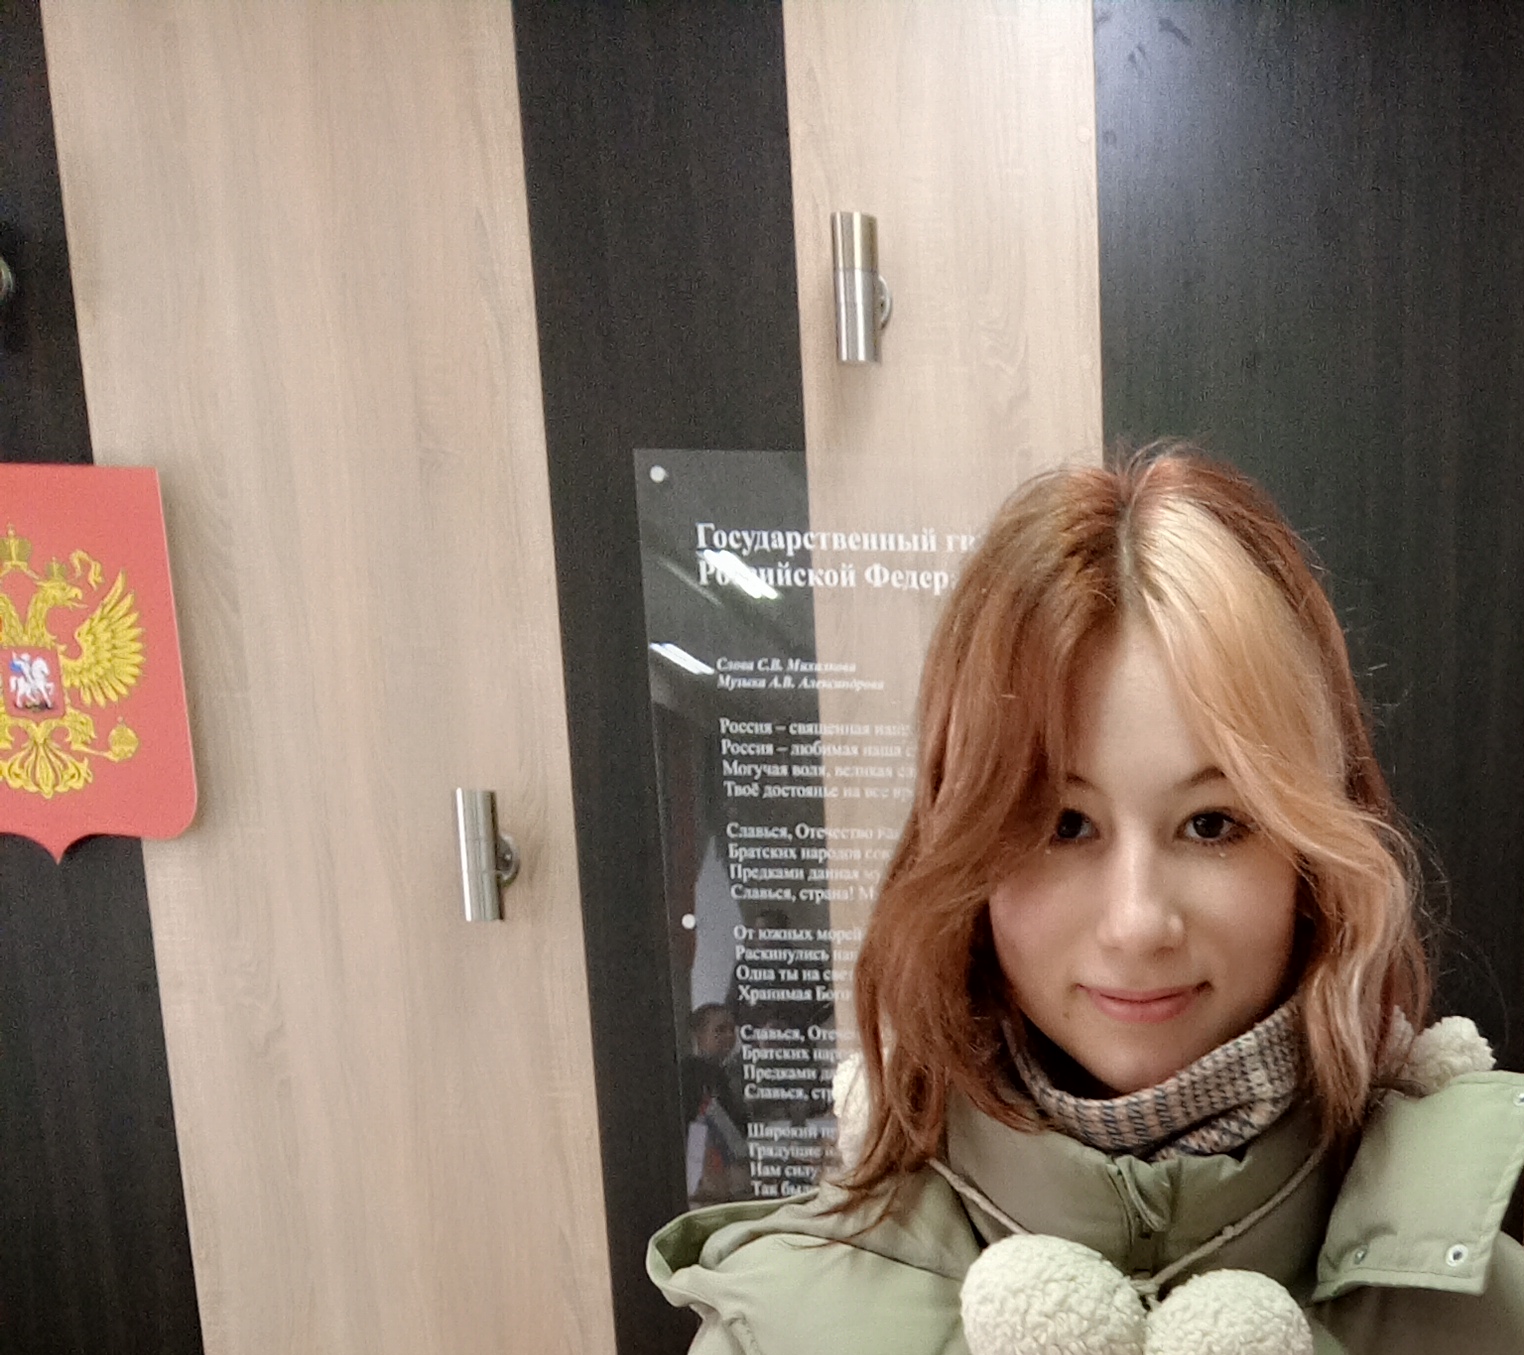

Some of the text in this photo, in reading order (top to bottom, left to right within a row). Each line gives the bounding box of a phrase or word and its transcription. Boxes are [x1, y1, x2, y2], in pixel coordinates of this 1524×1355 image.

[695, 522, 937, 556] Государственный
[698, 559, 955, 595] Роийской Федер
[716, 657, 754, 672] Слова
[757, 658, 783, 672] С.В.
[716, 674, 766, 691] Музыка
[768, 676, 795, 689] А.В.
[719, 718, 772, 735] Россия
[721, 739, 774, 755] Россия
[790, 740, 858, 756] любимая
[722, 760, 788, 780] Могучая
[723, 780, 759, 797] Твоё
[763, 786, 839, 800] достоянье
[726, 822, 793, 841] Славься,
[795, 823, 873, 839] Отечество
[728, 843, 796, 862] Братских
[801, 847, 861, 863] народов
[729, 864, 804, 882] Предками
[730, 884, 796, 902] Славься,
[733, 924, 755, 940] От
[735, 945, 830, 965] Раскинулись
[736, 964, 776, 981] Одна
[779, 968, 798, 981] ты
[802, 968, 820, 981] на
[738, 984, 812, 1006] Хранимая
[740, 1024, 805, 1042] Славься,
[742, 1044, 810, 1062] Братских
[743, 1064, 817, 1083] Предками
